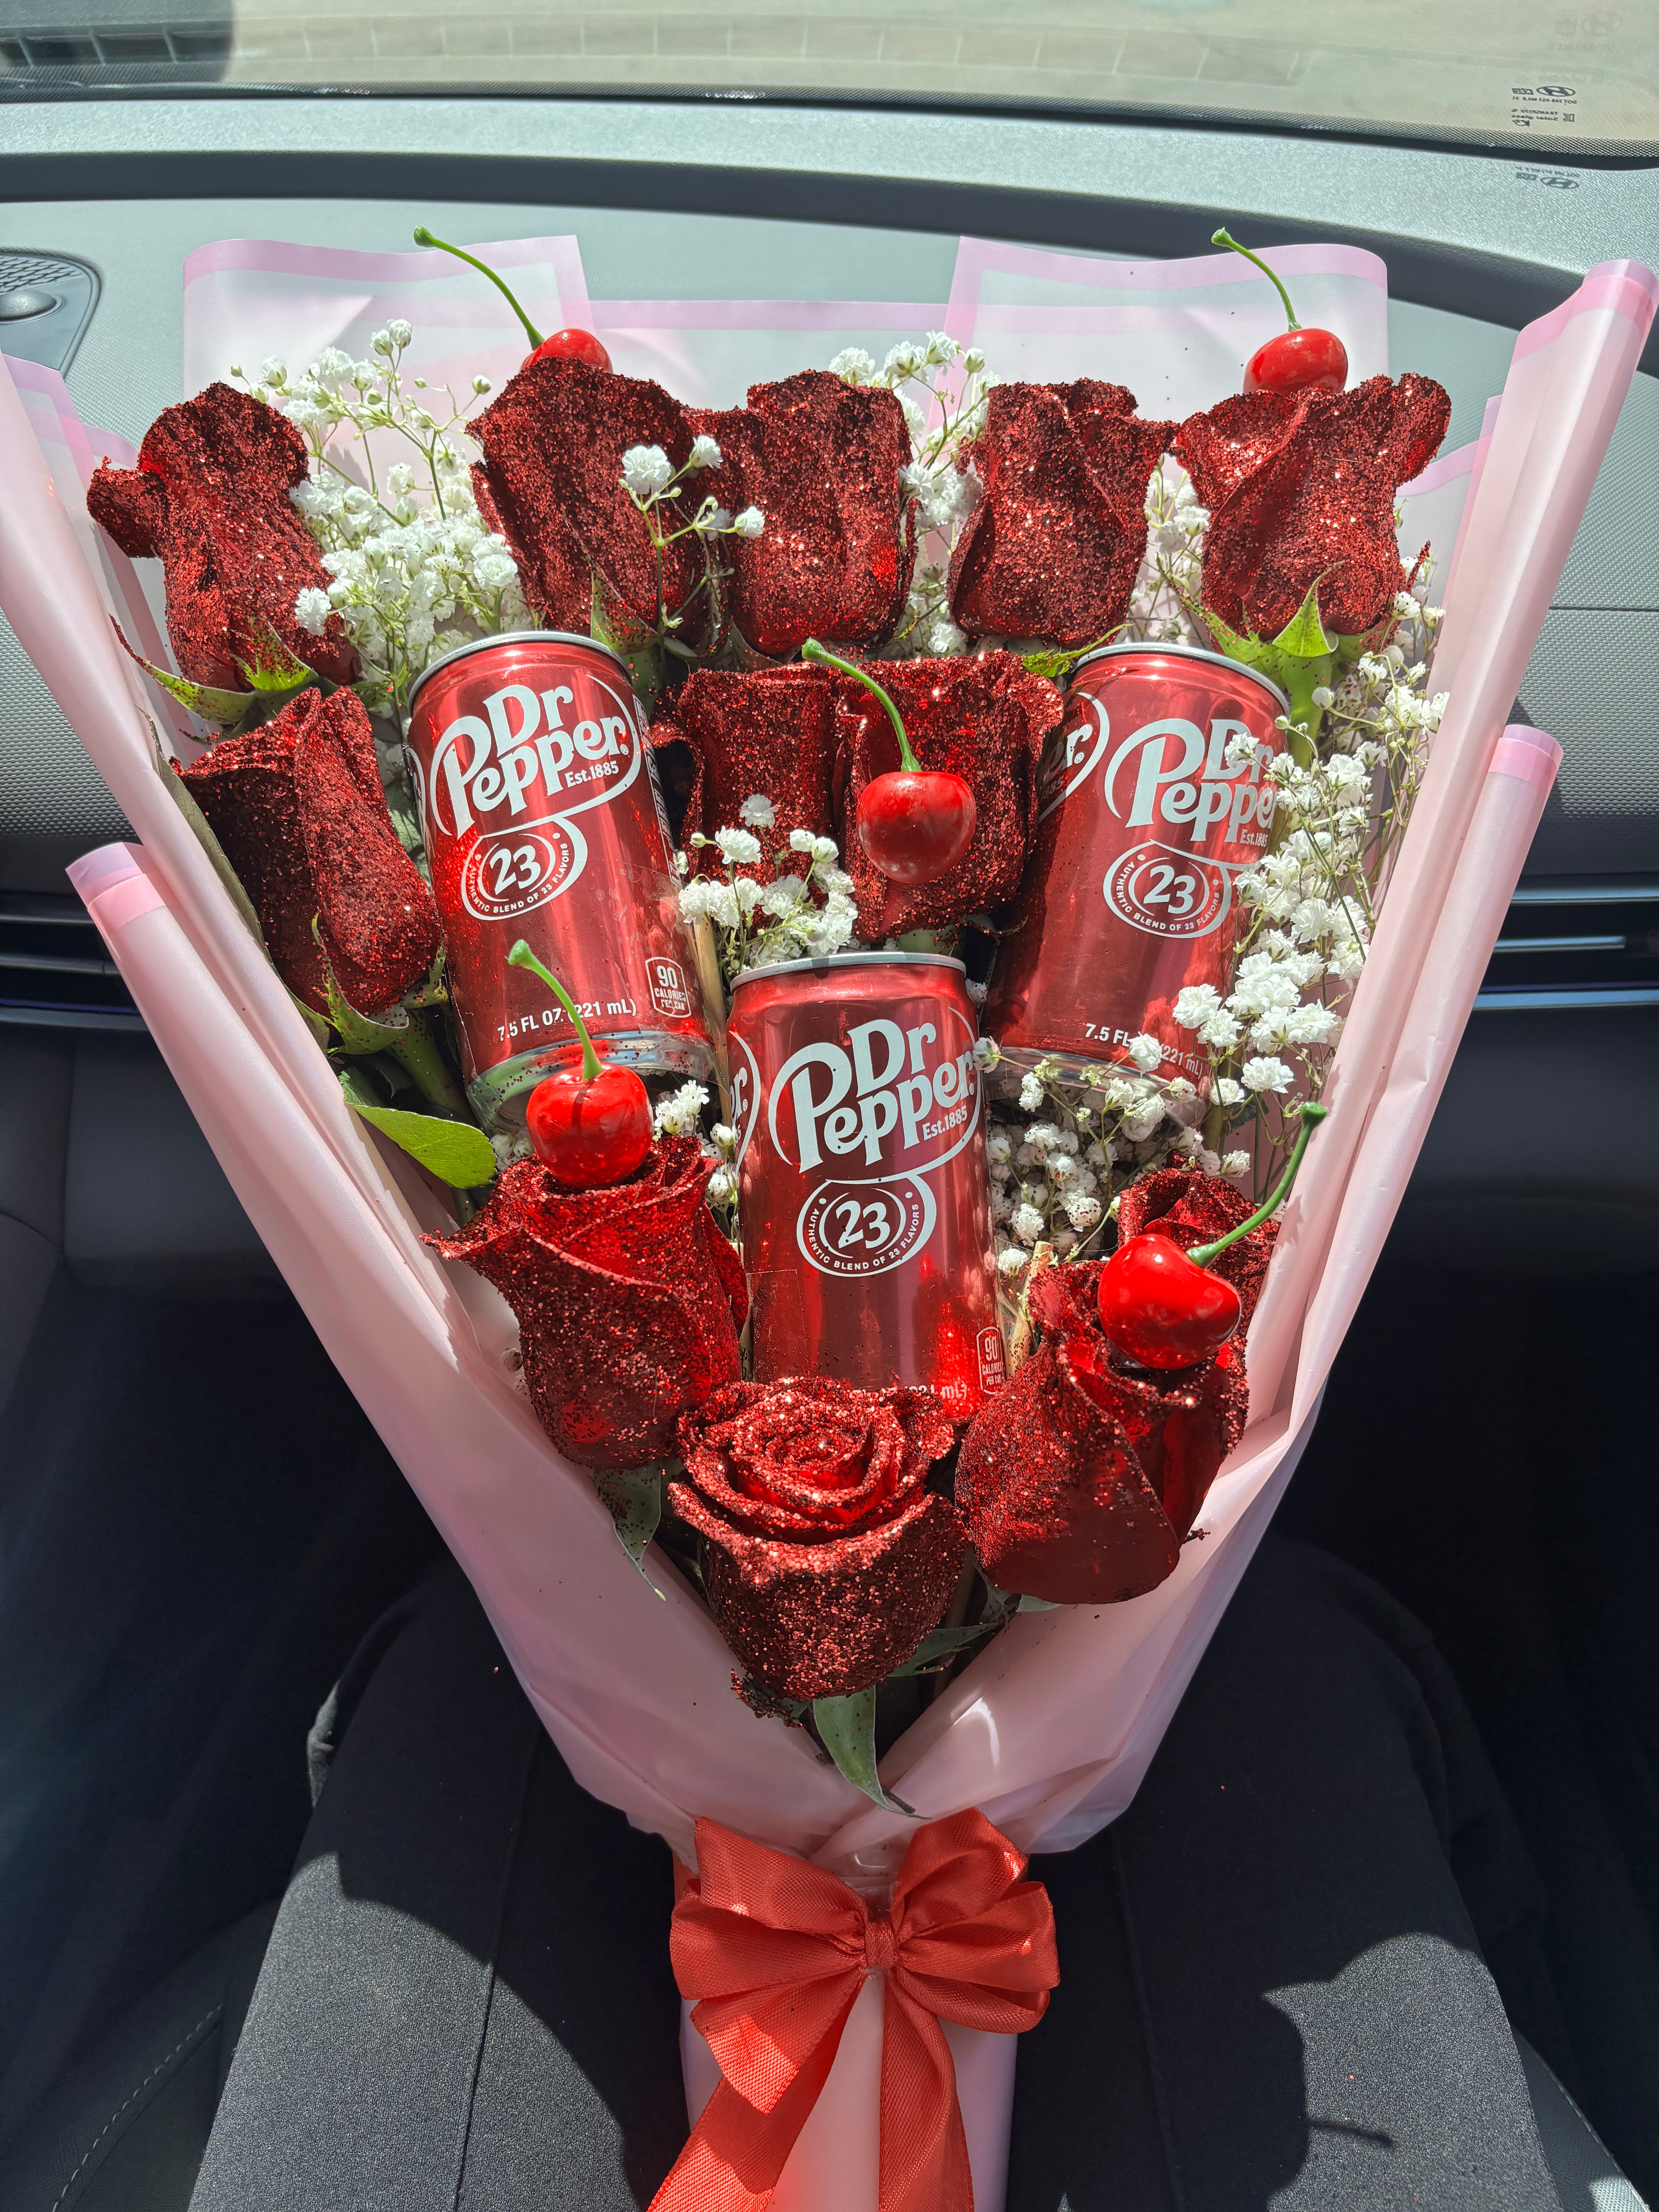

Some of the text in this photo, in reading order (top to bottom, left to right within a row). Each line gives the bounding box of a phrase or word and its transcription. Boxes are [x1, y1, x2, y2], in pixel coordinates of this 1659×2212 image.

[483, 684, 573, 758] Dr
[468, 843, 569, 913] AUTHENTIC BLEND OF 23 FLAVORS
[489, 845, 541, 895] 23
[1143, 865, 1195, 914] 23
[1116, 861, 1135, 913] AUTHENTIC
[1133, 912, 1166, 930] BLEND
[1185, 922, 1194, 930] 23
[1196, 892, 1219, 926] FLAVORS
[654, 988, 686, 1002] CALORIES
[657, 965, 678, 989] 90
[498, 1021, 518, 1041] 7.5
[521, 1015, 539, 1032] FL
[607, 998, 636, 1017] mL)
[674, 1001, 685, 1011] CAN
[847, 1019, 936, 1097] Dr
[1085, 1023, 1110, 1041] 7.5
[1113, 1030, 1130, 1047] FL
[768, 1042, 973, 1174] Pepper
[808, 1204, 919, 1270] AUTHENTIC BLEND OF 23 FLAVORS
[835, 1200, 890, 1249] 23
[985, 1336, 998, 1361] 90
